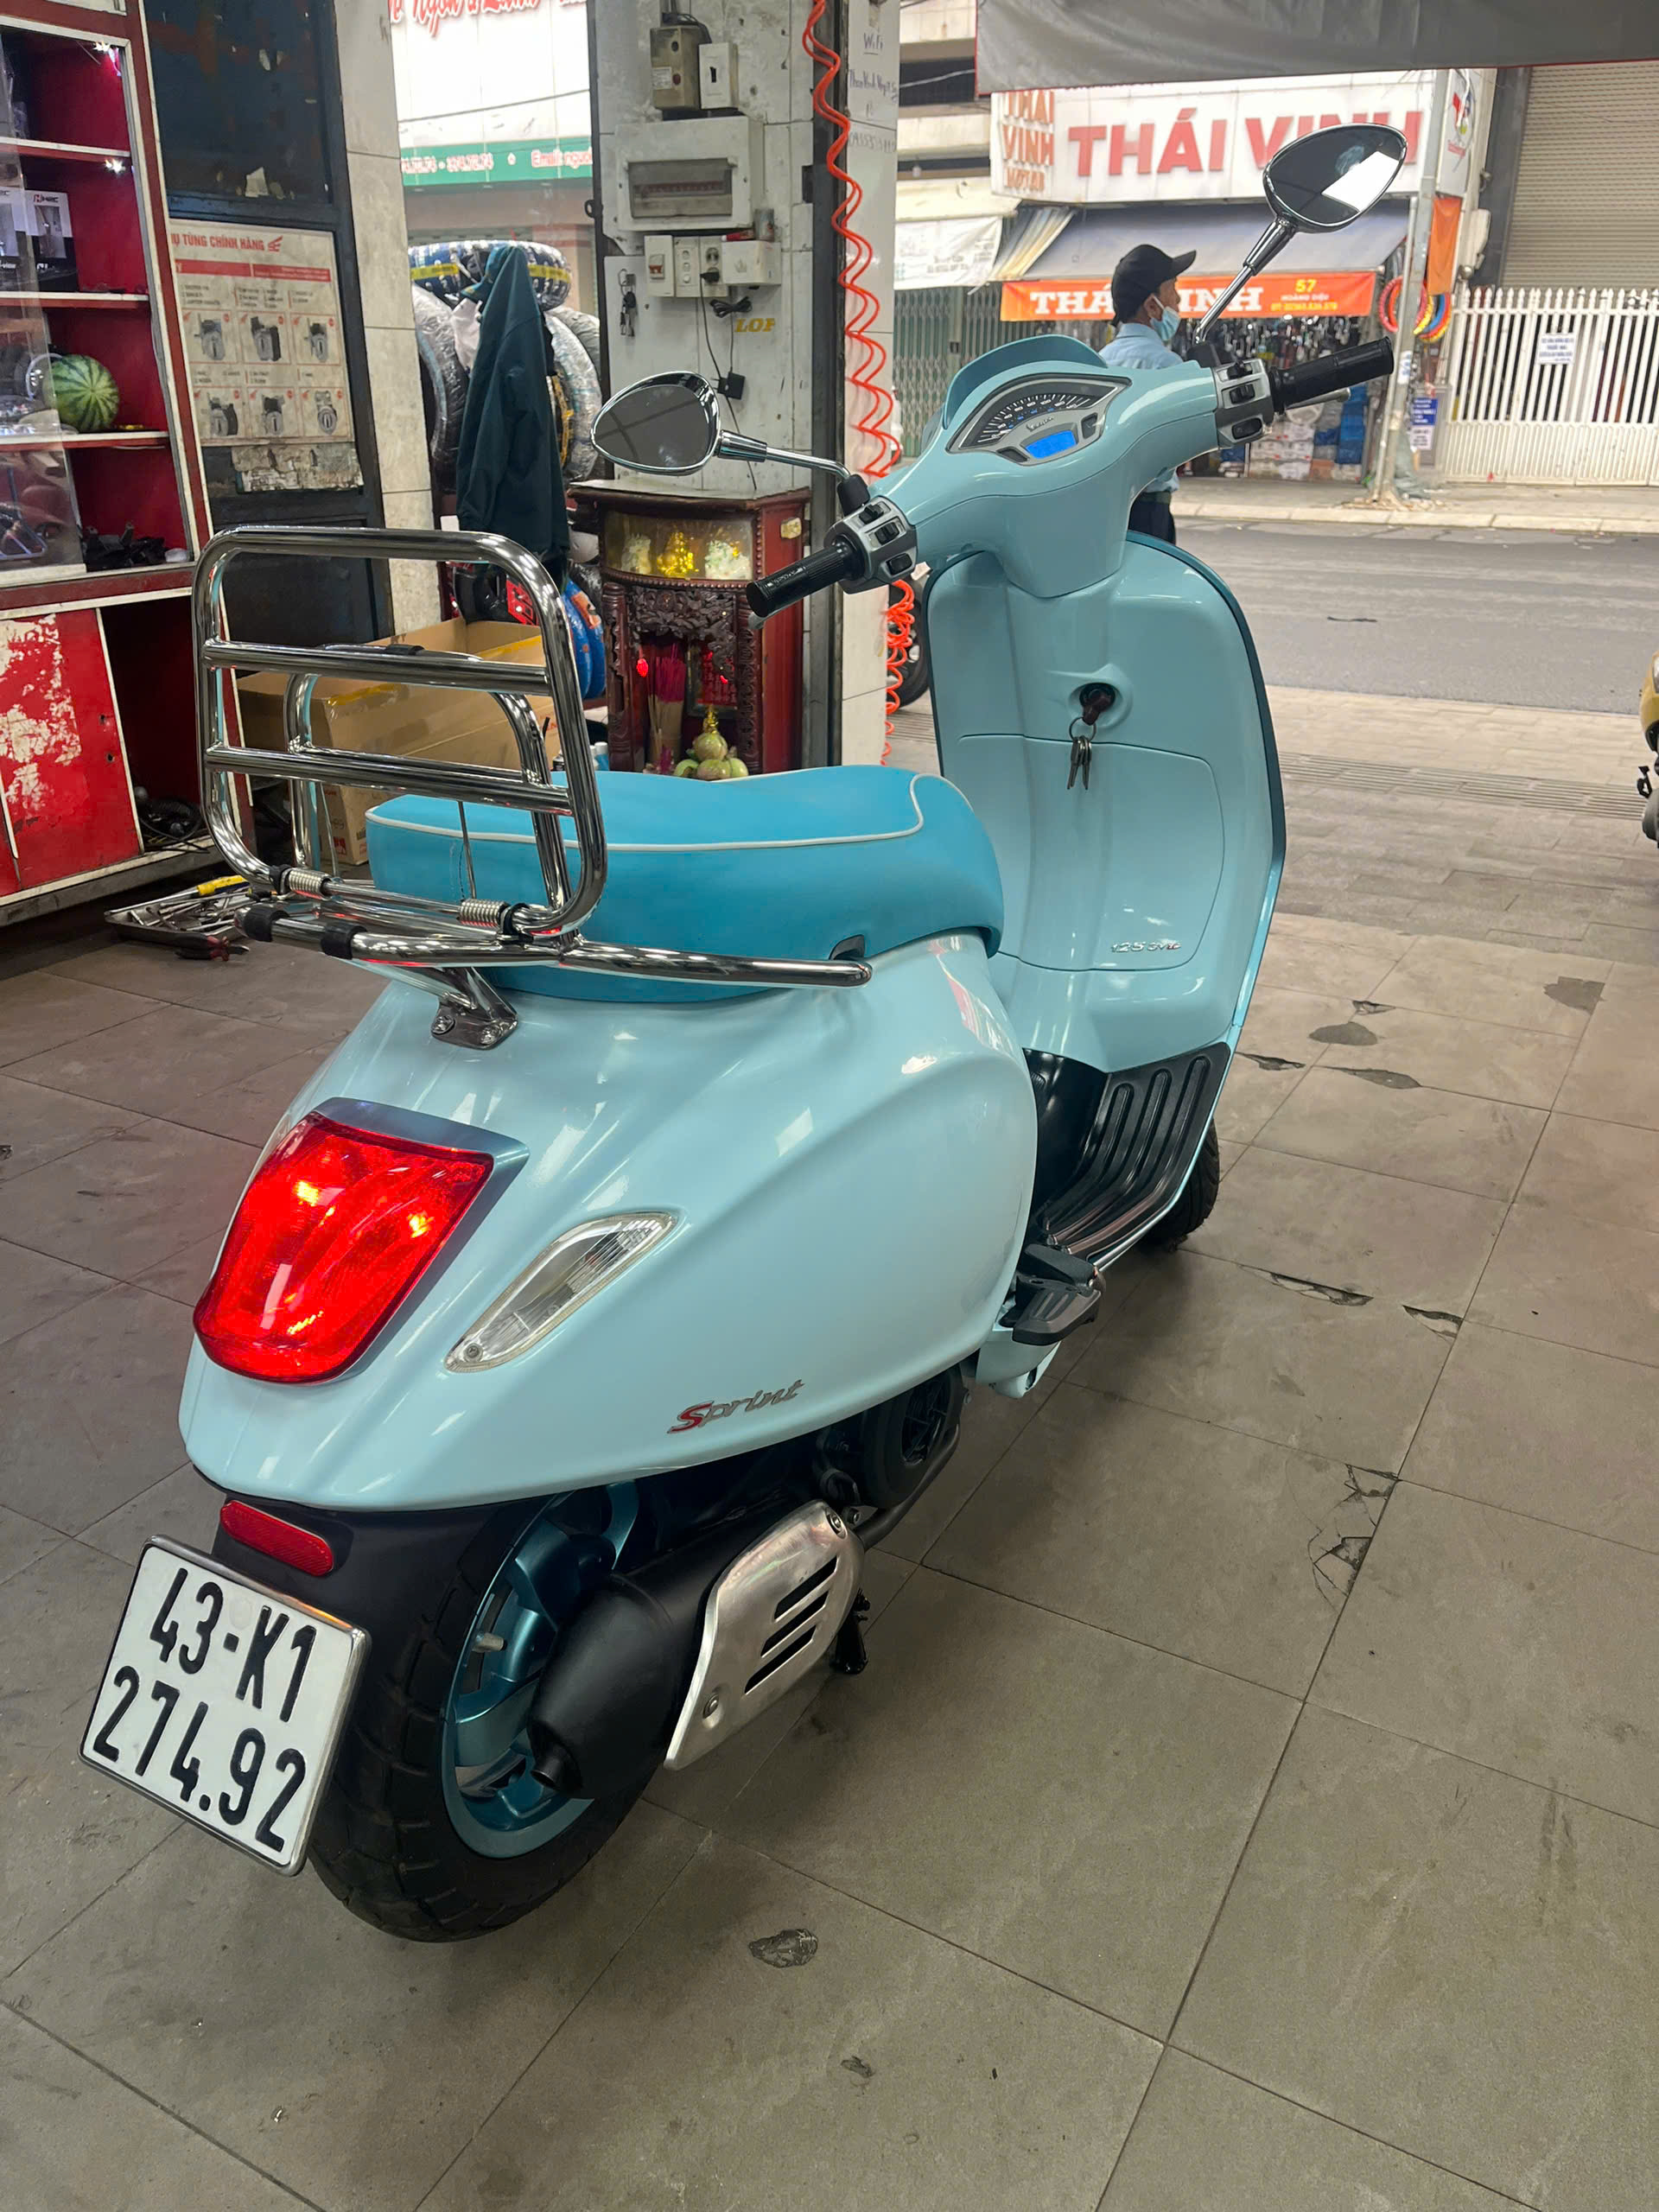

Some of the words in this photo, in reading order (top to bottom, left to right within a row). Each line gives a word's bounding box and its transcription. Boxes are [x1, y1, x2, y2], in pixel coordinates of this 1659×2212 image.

[1002, 125, 1054, 167] VINH
[1068, 107, 1228, 177] THÁI
[181, 232, 208, 247] TÙNG
[209, 235, 238, 250] CHÍNH
[239, 237, 265, 252] HÀNG
[1030, 283, 1115, 315] THÁ
[1295, 278, 1317, 293] 57
[667, 1379, 804, 1434] Sprint
[149, 1567, 317, 1723] 43-K1
[92, 1665, 307, 1853] 274.92
